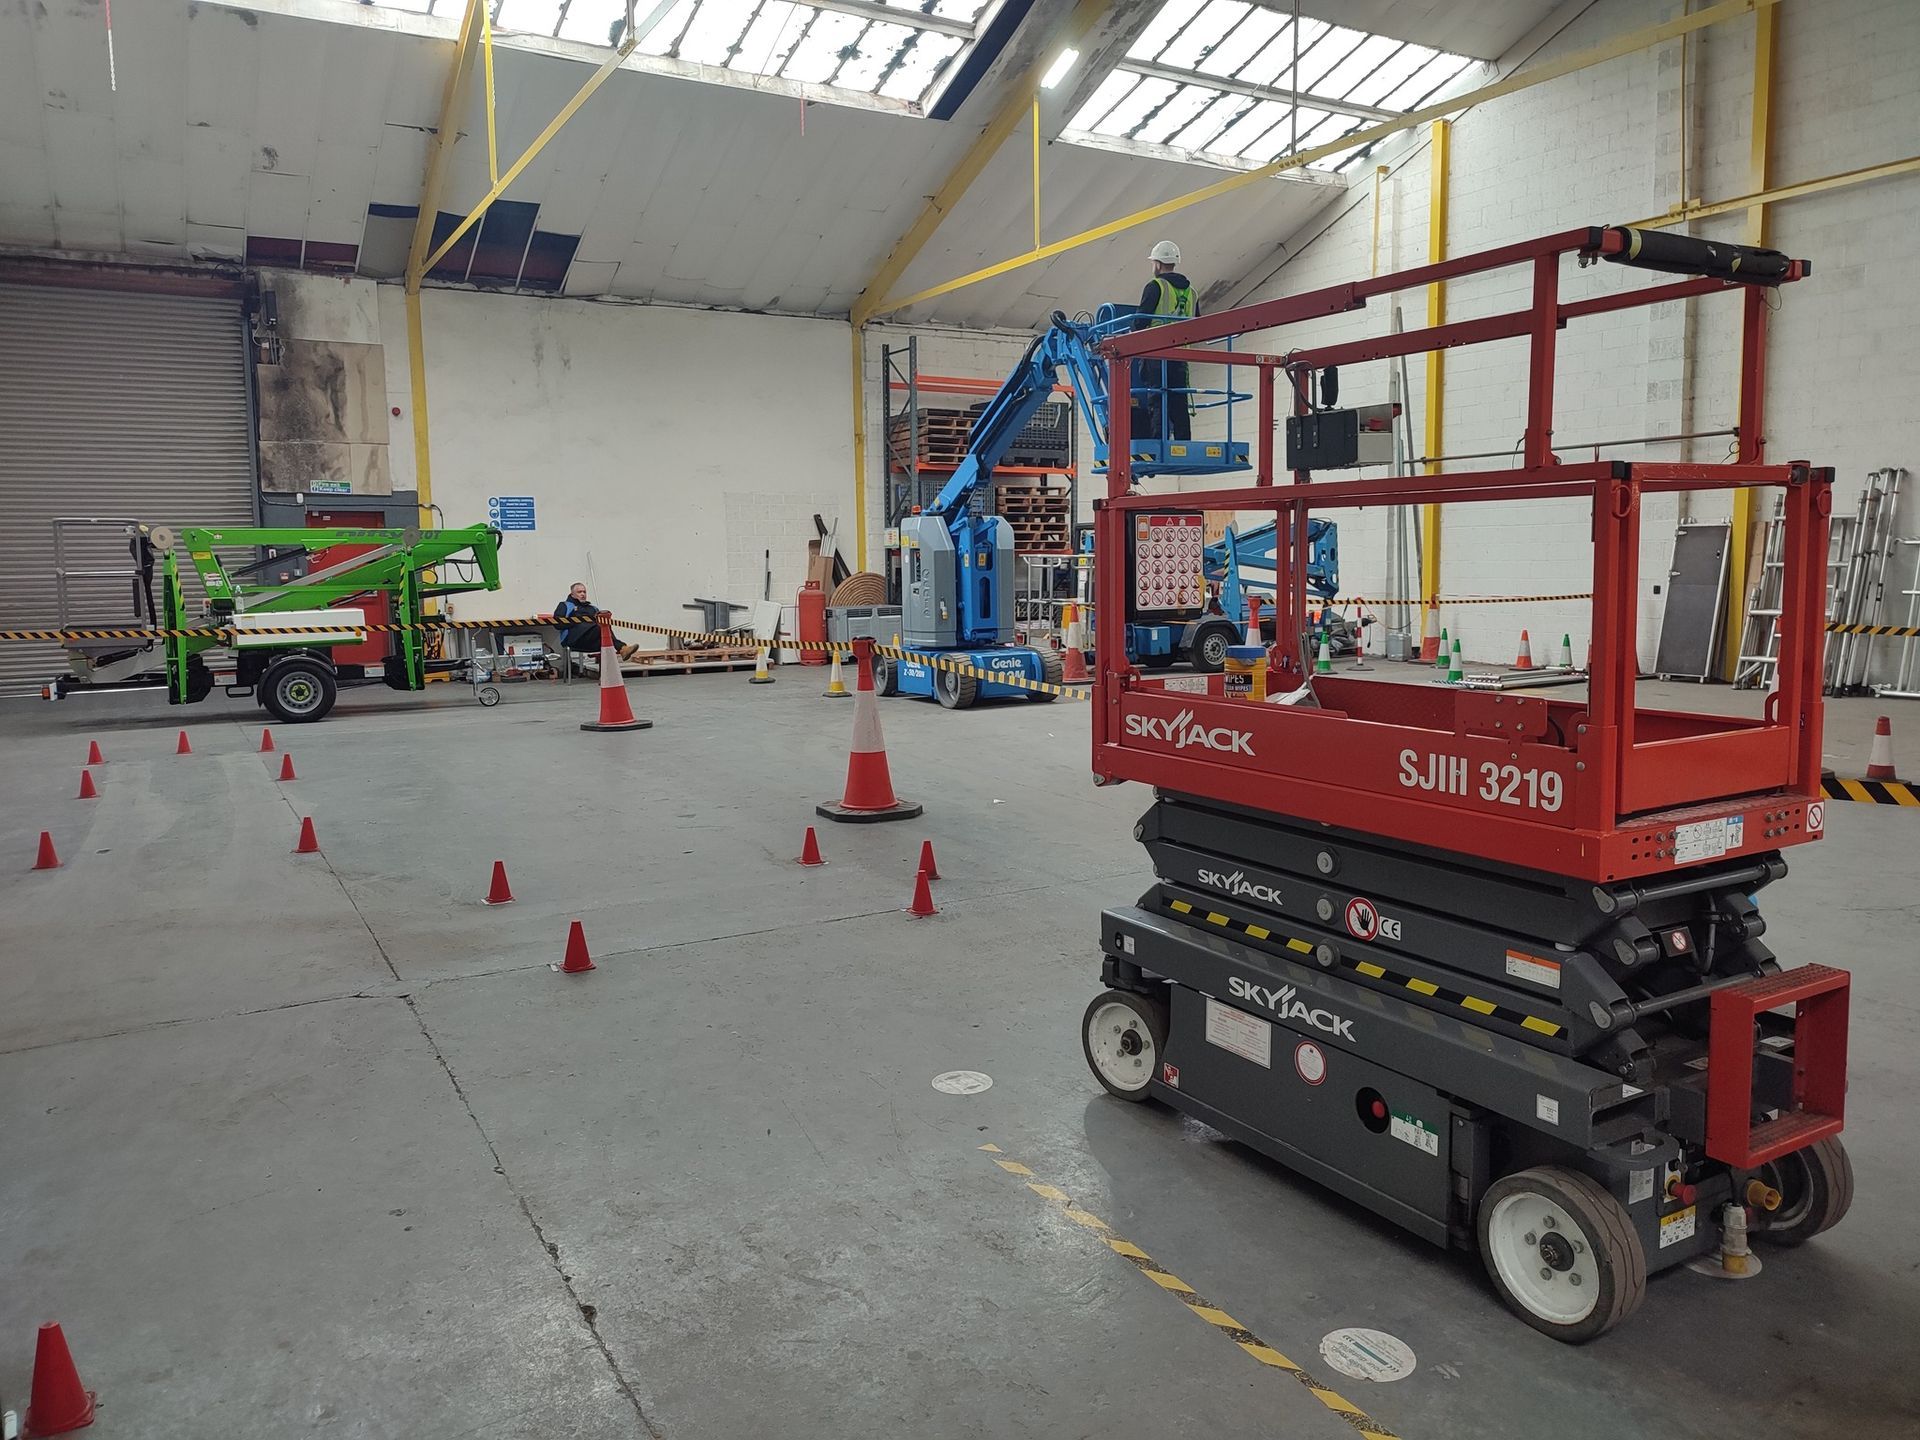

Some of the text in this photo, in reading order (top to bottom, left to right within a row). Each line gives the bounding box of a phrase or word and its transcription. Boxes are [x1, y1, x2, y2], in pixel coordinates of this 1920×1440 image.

[991, 657, 1022, 669] Genie
[1125, 708, 1256, 757] SKYJACK
[1479, 761, 1563, 812] 3219
[1198, 869, 1283, 906] SKYJACK
[1228, 976, 1357, 1042] SKYJACK
